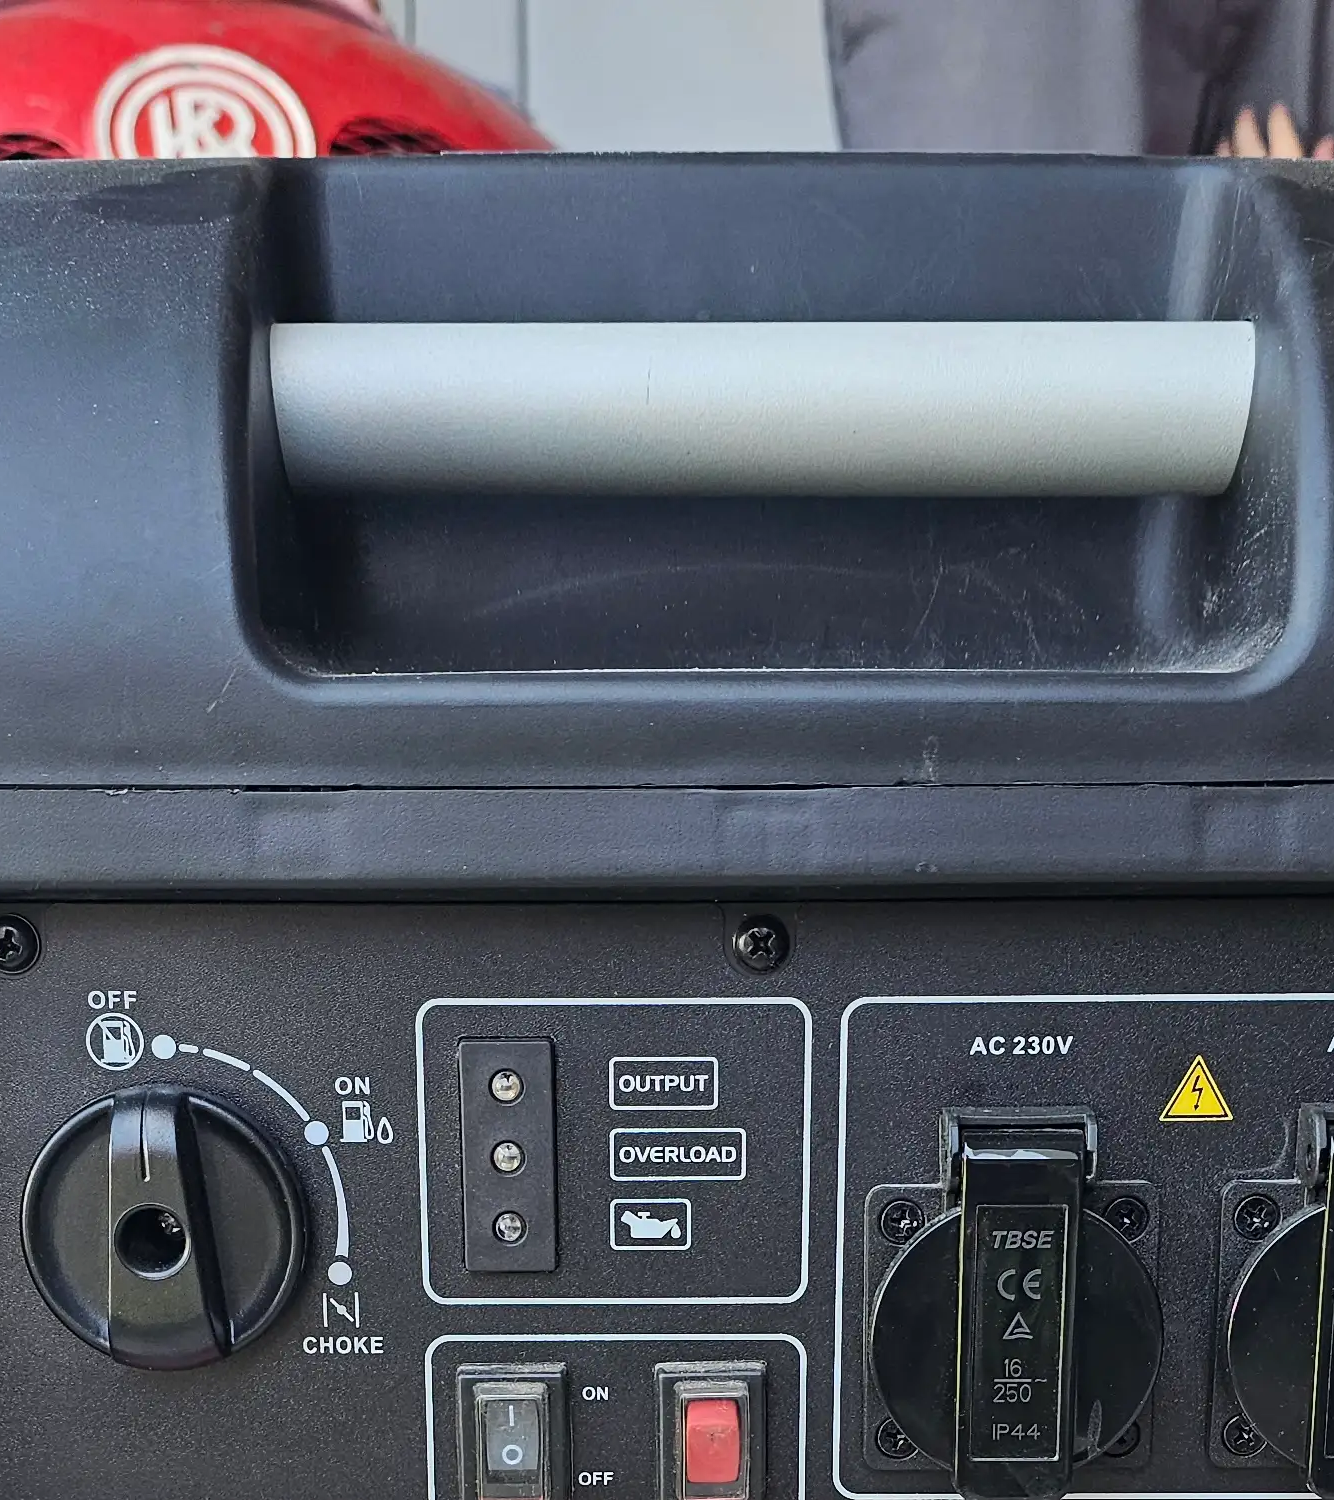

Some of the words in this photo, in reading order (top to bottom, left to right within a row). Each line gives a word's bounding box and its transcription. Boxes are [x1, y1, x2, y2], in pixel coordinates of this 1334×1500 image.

[87, 990, 137, 1010] OFF
[970, 1035, 1006, 1055] AC
[1012, 1035, 1074, 1055] 230V
[334, 1076, 371, 1095] ON
[619, 1074, 709, 1093] OUTPUT
[619, 1145, 737, 1164] OVERLOAD
[991, 1230, 1055, 1250] TBSE
[302, 1336, 384, 1354] CHOKE
[582, 1386, 609, 1401] ON
[992, 1424, 1041, 1441] IP44
[578, 1471, 614, 1487] OFF
